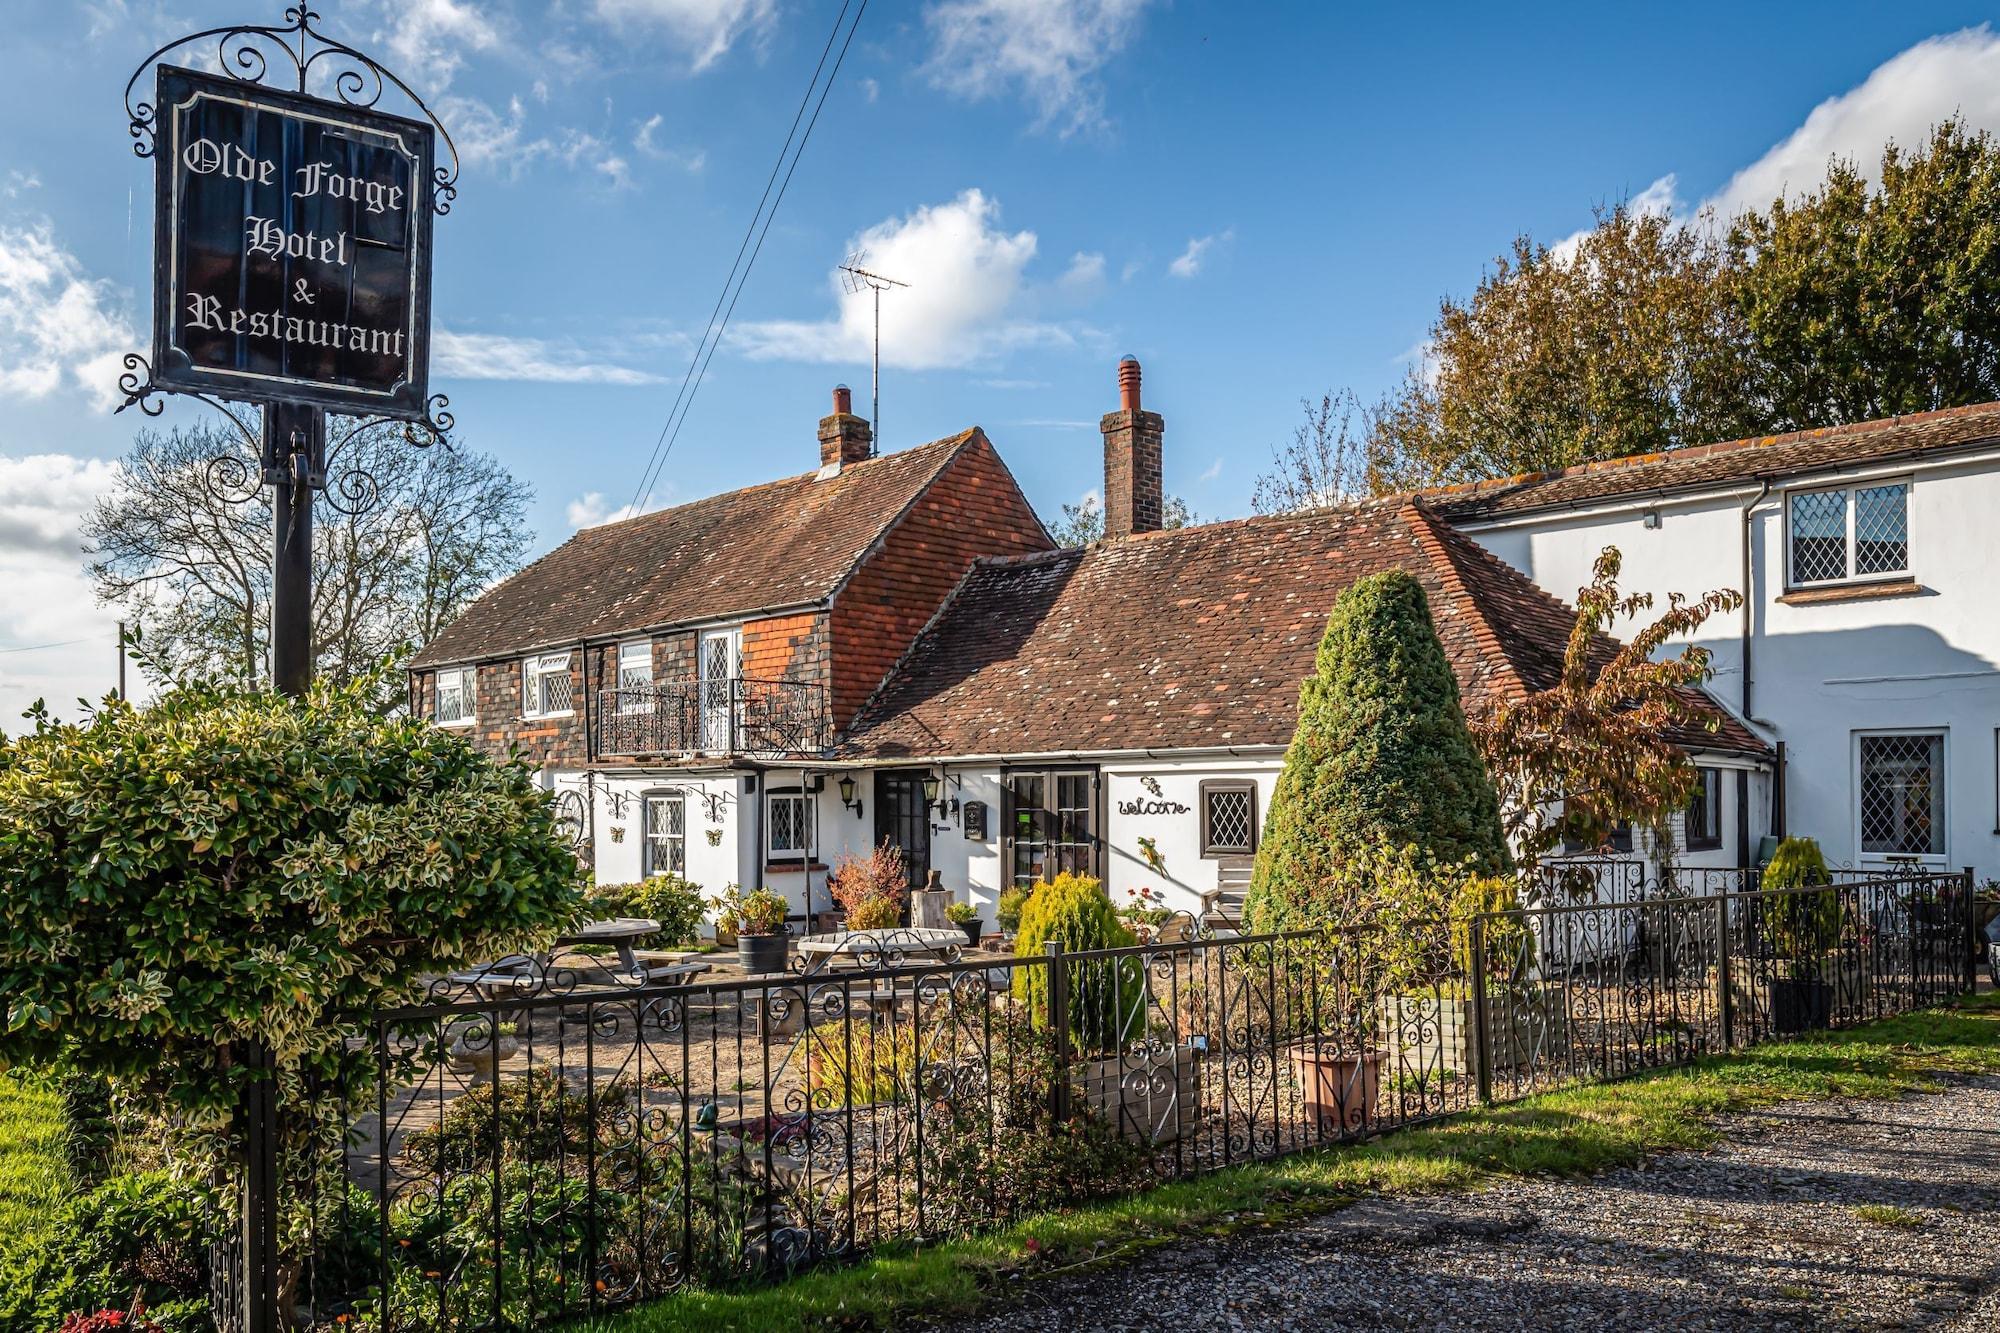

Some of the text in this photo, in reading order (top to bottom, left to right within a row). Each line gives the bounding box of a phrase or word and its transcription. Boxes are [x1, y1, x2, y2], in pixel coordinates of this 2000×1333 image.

[183, 138, 404, 214] Olde Forge
[245, 216, 347, 266] Hotel
[293, 278, 315, 305] &
[185, 292, 405, 358] Restaurant
